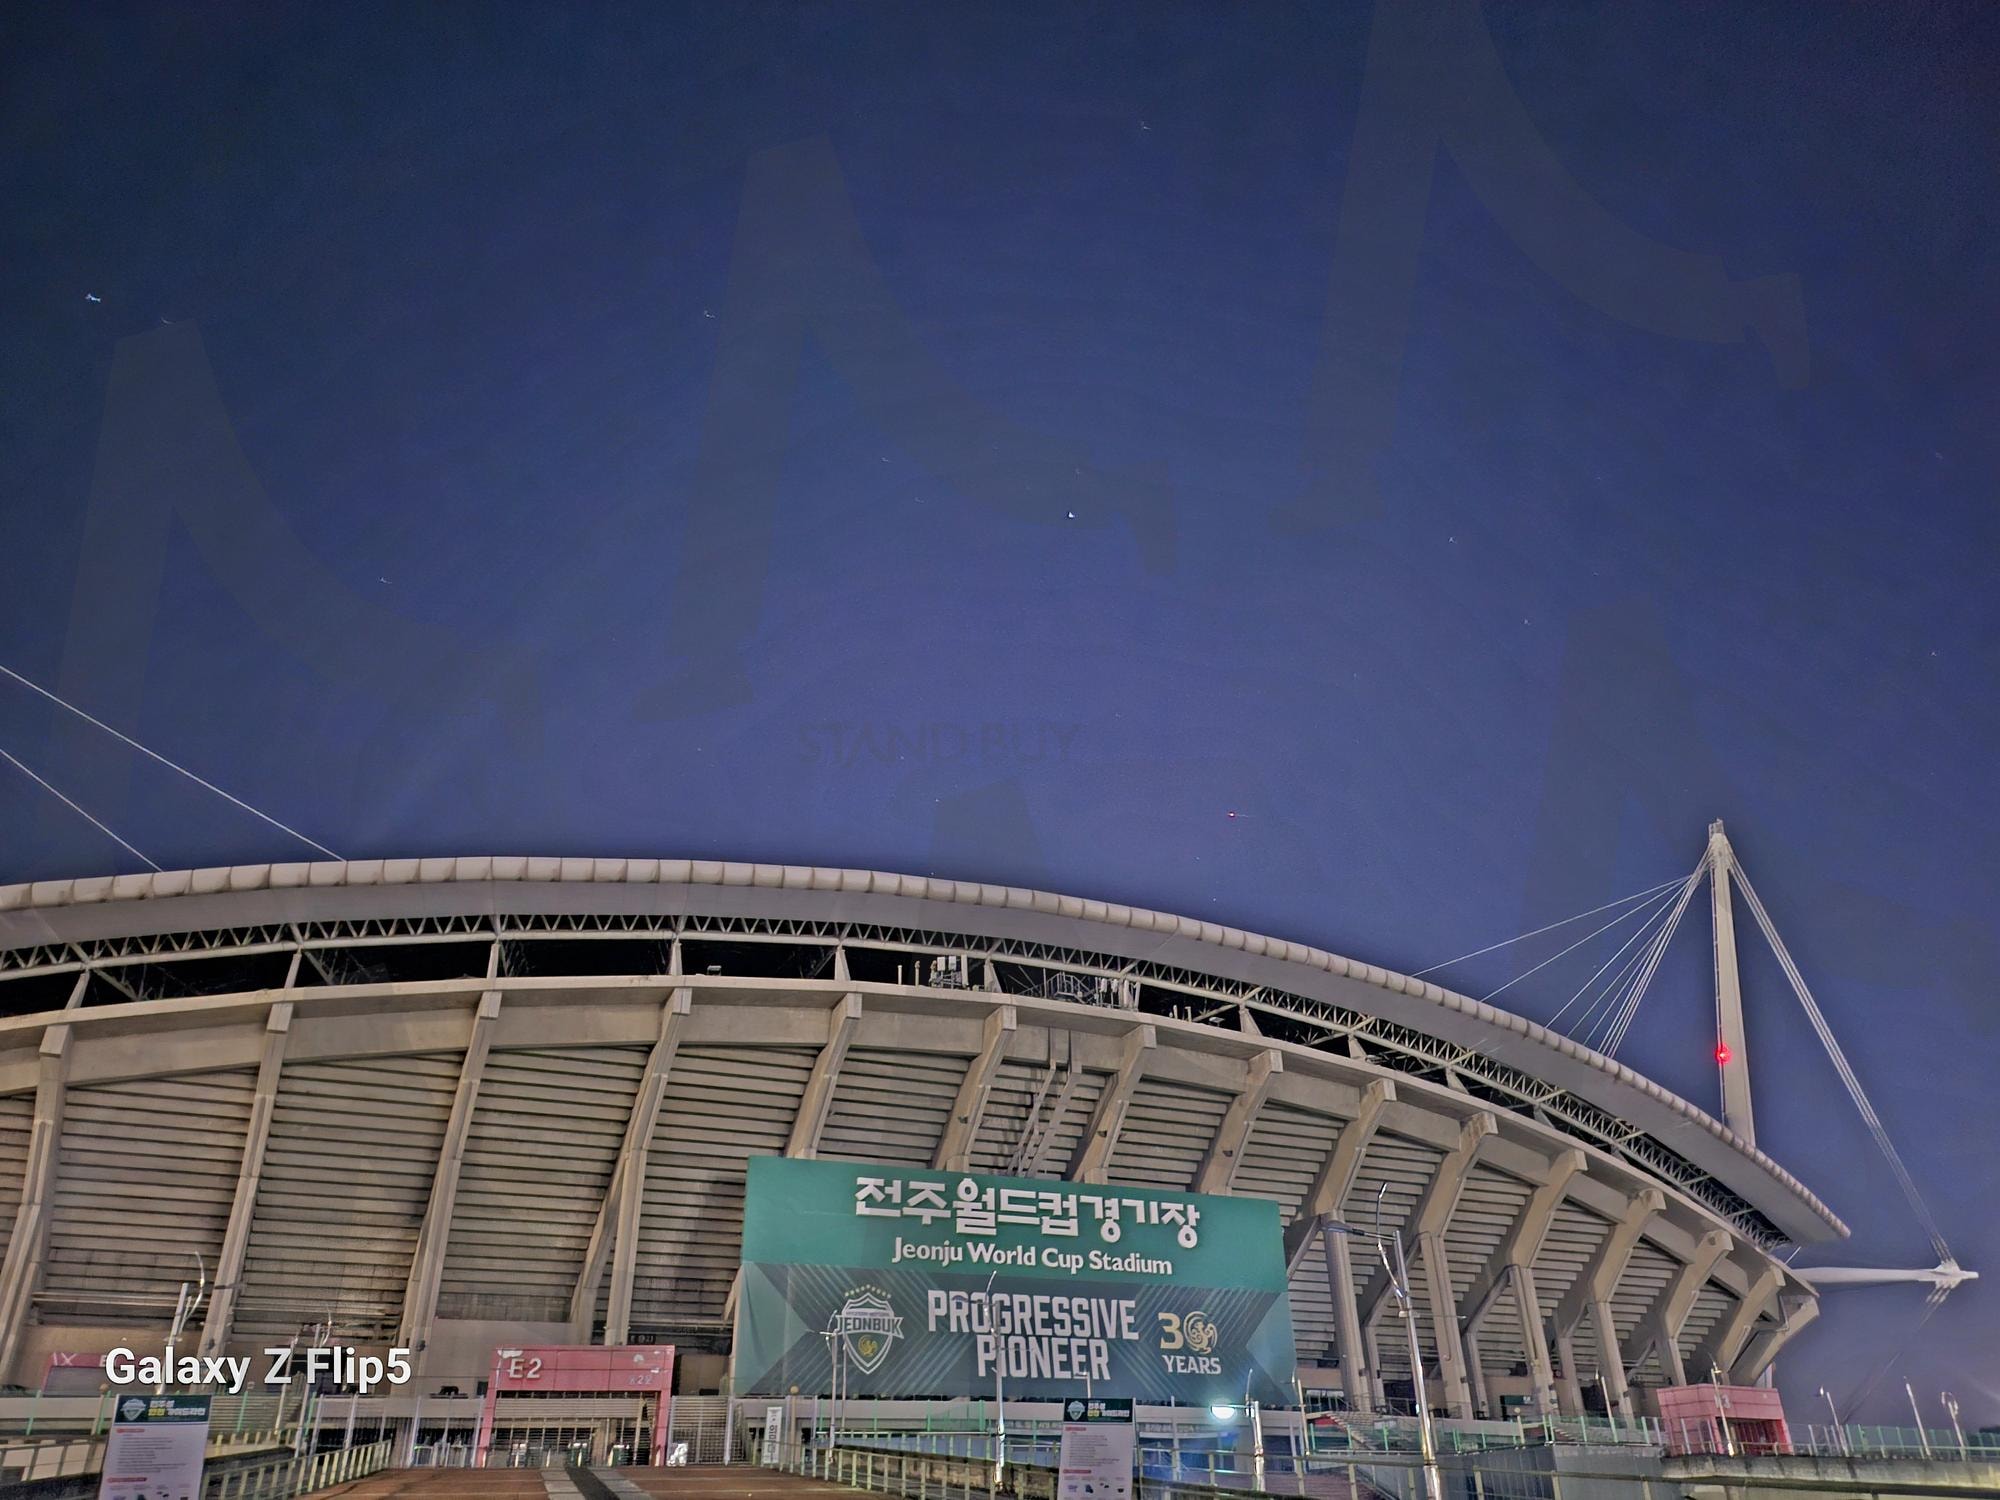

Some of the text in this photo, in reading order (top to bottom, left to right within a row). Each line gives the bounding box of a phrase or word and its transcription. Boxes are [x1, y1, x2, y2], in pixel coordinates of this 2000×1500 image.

[855, 1176, 1200, 1249] 전주월드컵경기장
[892, 1237, 1173, 1275] Jeonju World Cup Stadium
[927, 1289, 1140, 1340] PROGRESSIVE
[509, 1358, 542, 1379] E2
[976, 1334, 1112, 1381] PIONEER
[1161, 1354, 1222, 1375] YEARS
